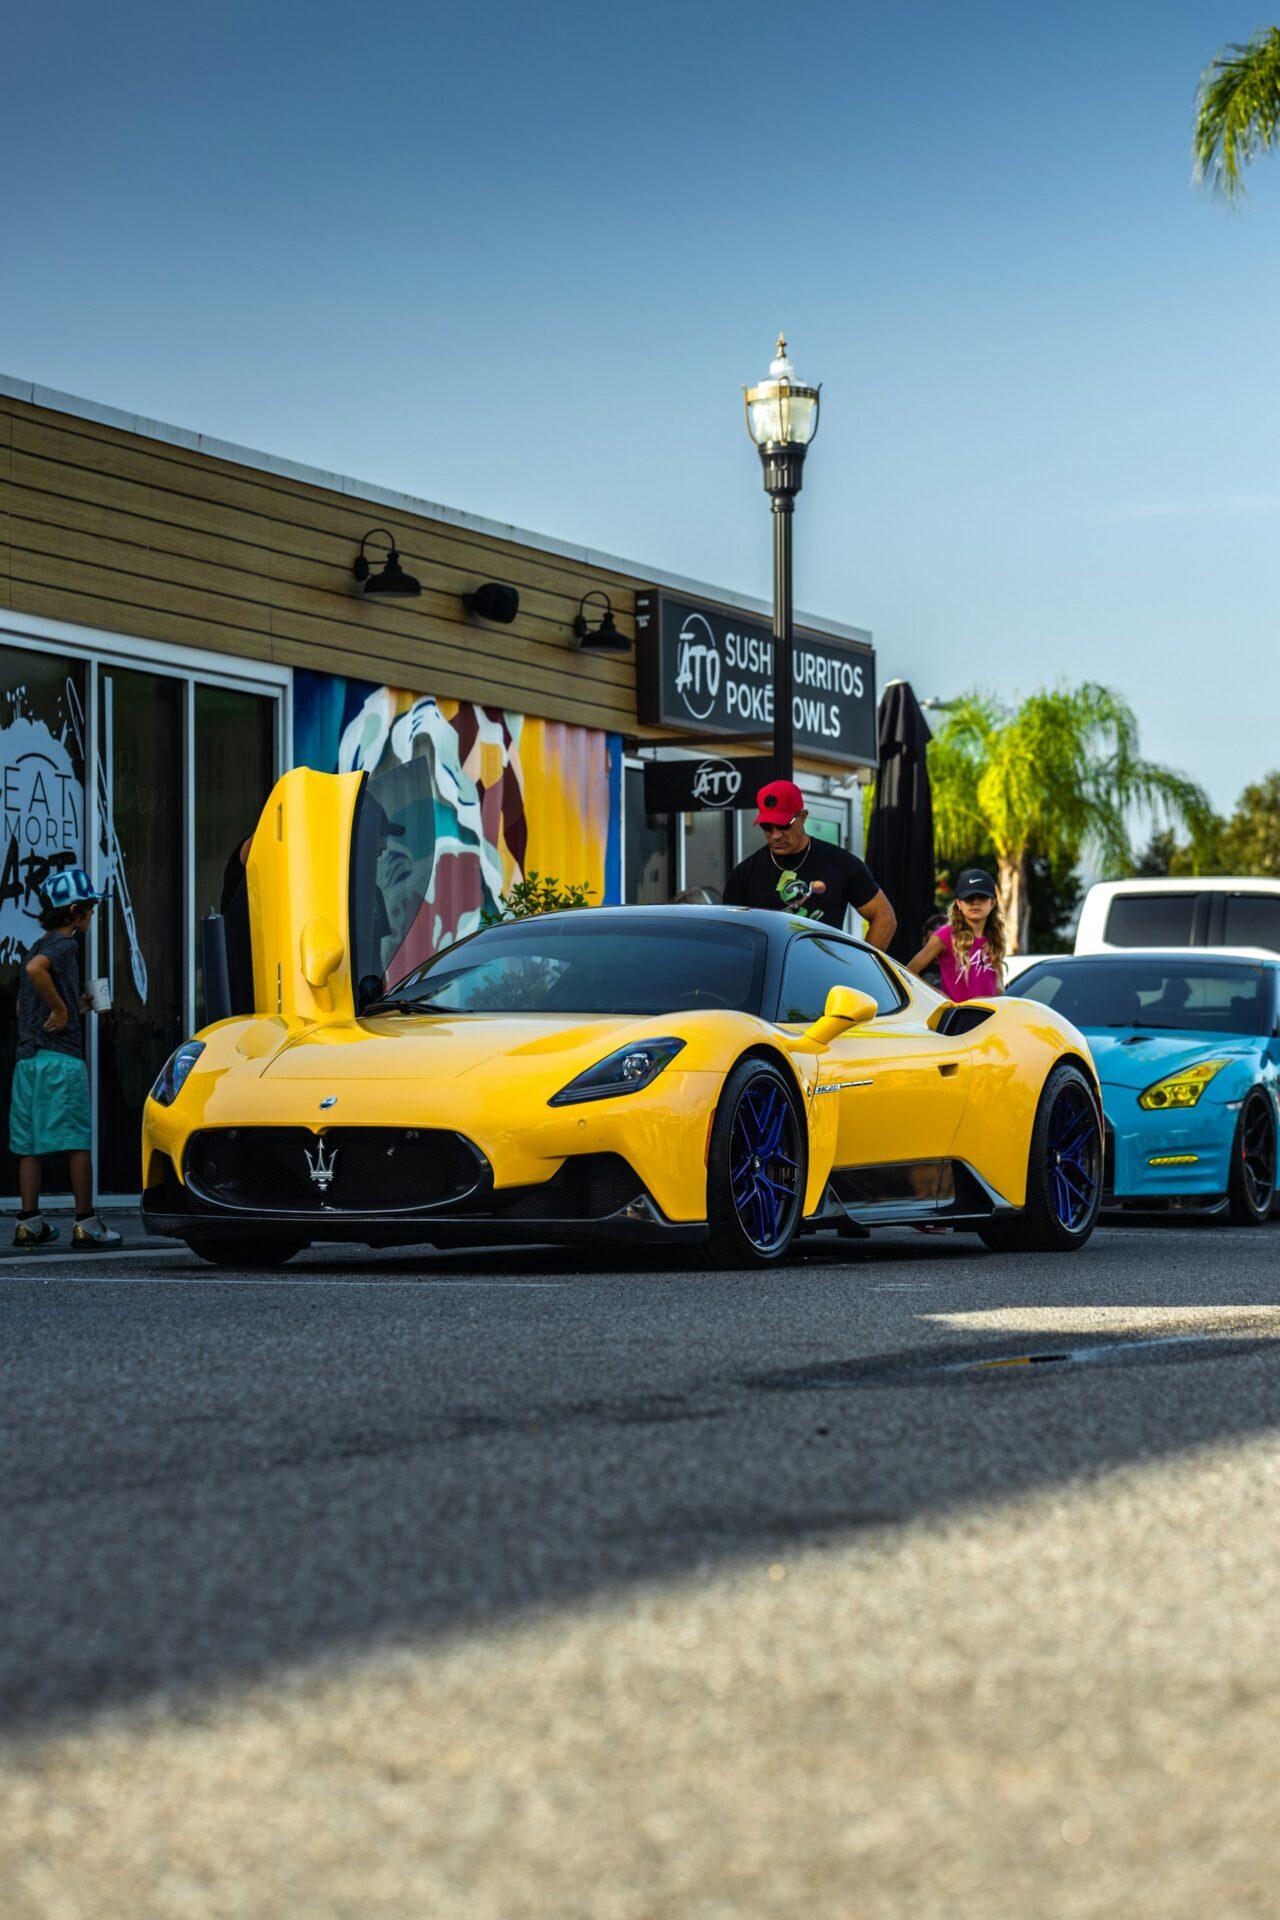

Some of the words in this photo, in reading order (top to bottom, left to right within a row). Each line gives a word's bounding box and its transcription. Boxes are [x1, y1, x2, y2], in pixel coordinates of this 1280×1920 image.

[792, 649, 864, 698] URRITOS
[792, 696, 841, 738] OWLS
[4, 766, 73, 818] EAT
[4, 813, 74, 850] MORE
